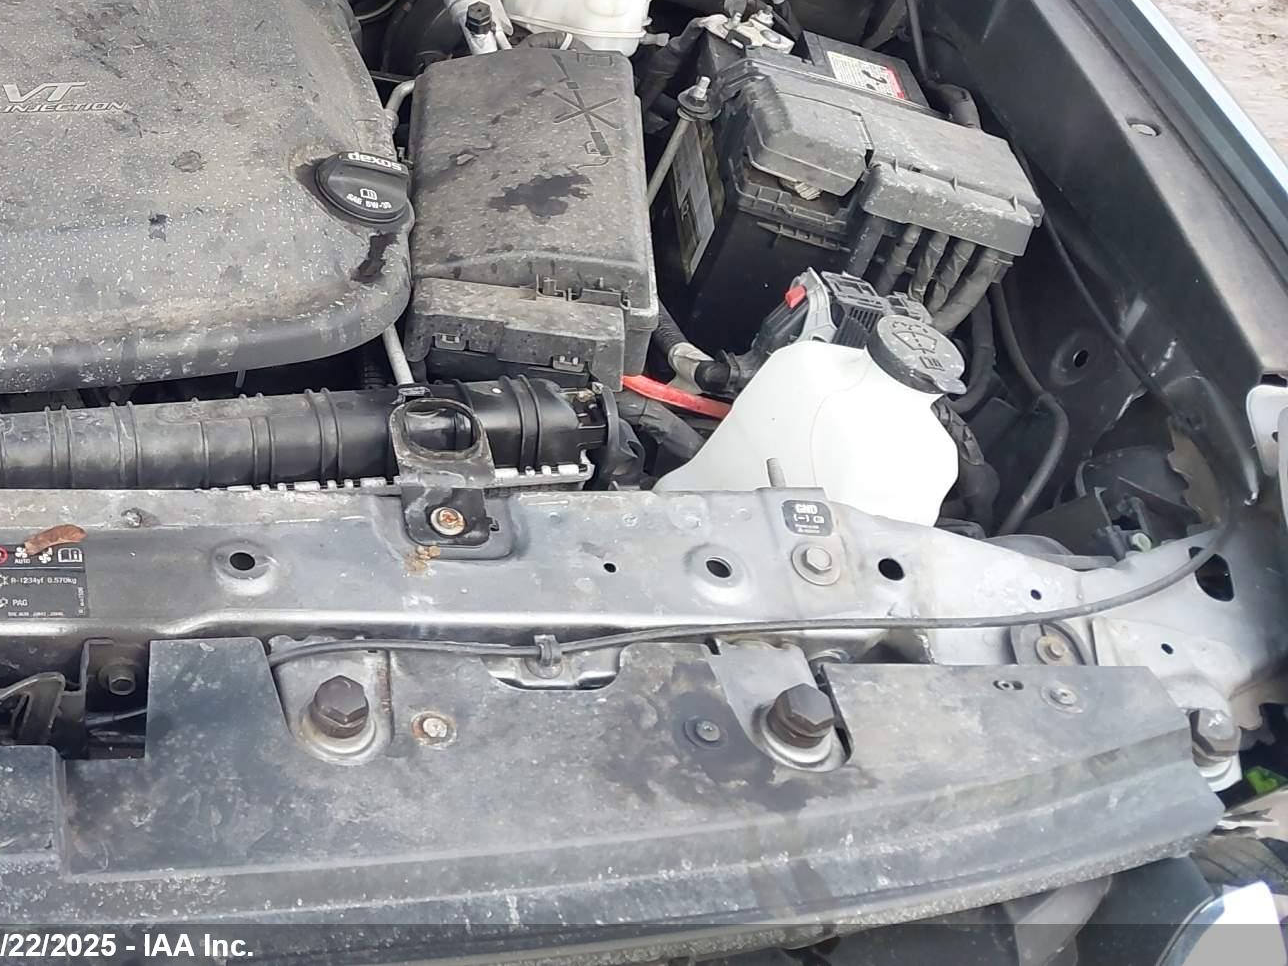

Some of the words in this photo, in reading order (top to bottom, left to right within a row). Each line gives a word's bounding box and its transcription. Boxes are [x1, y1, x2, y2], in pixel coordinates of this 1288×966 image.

[2, 101, 125, 114] INJECTION
[348, 152, 402, 171] dexos
[12, 599, 28, 607] PAG
